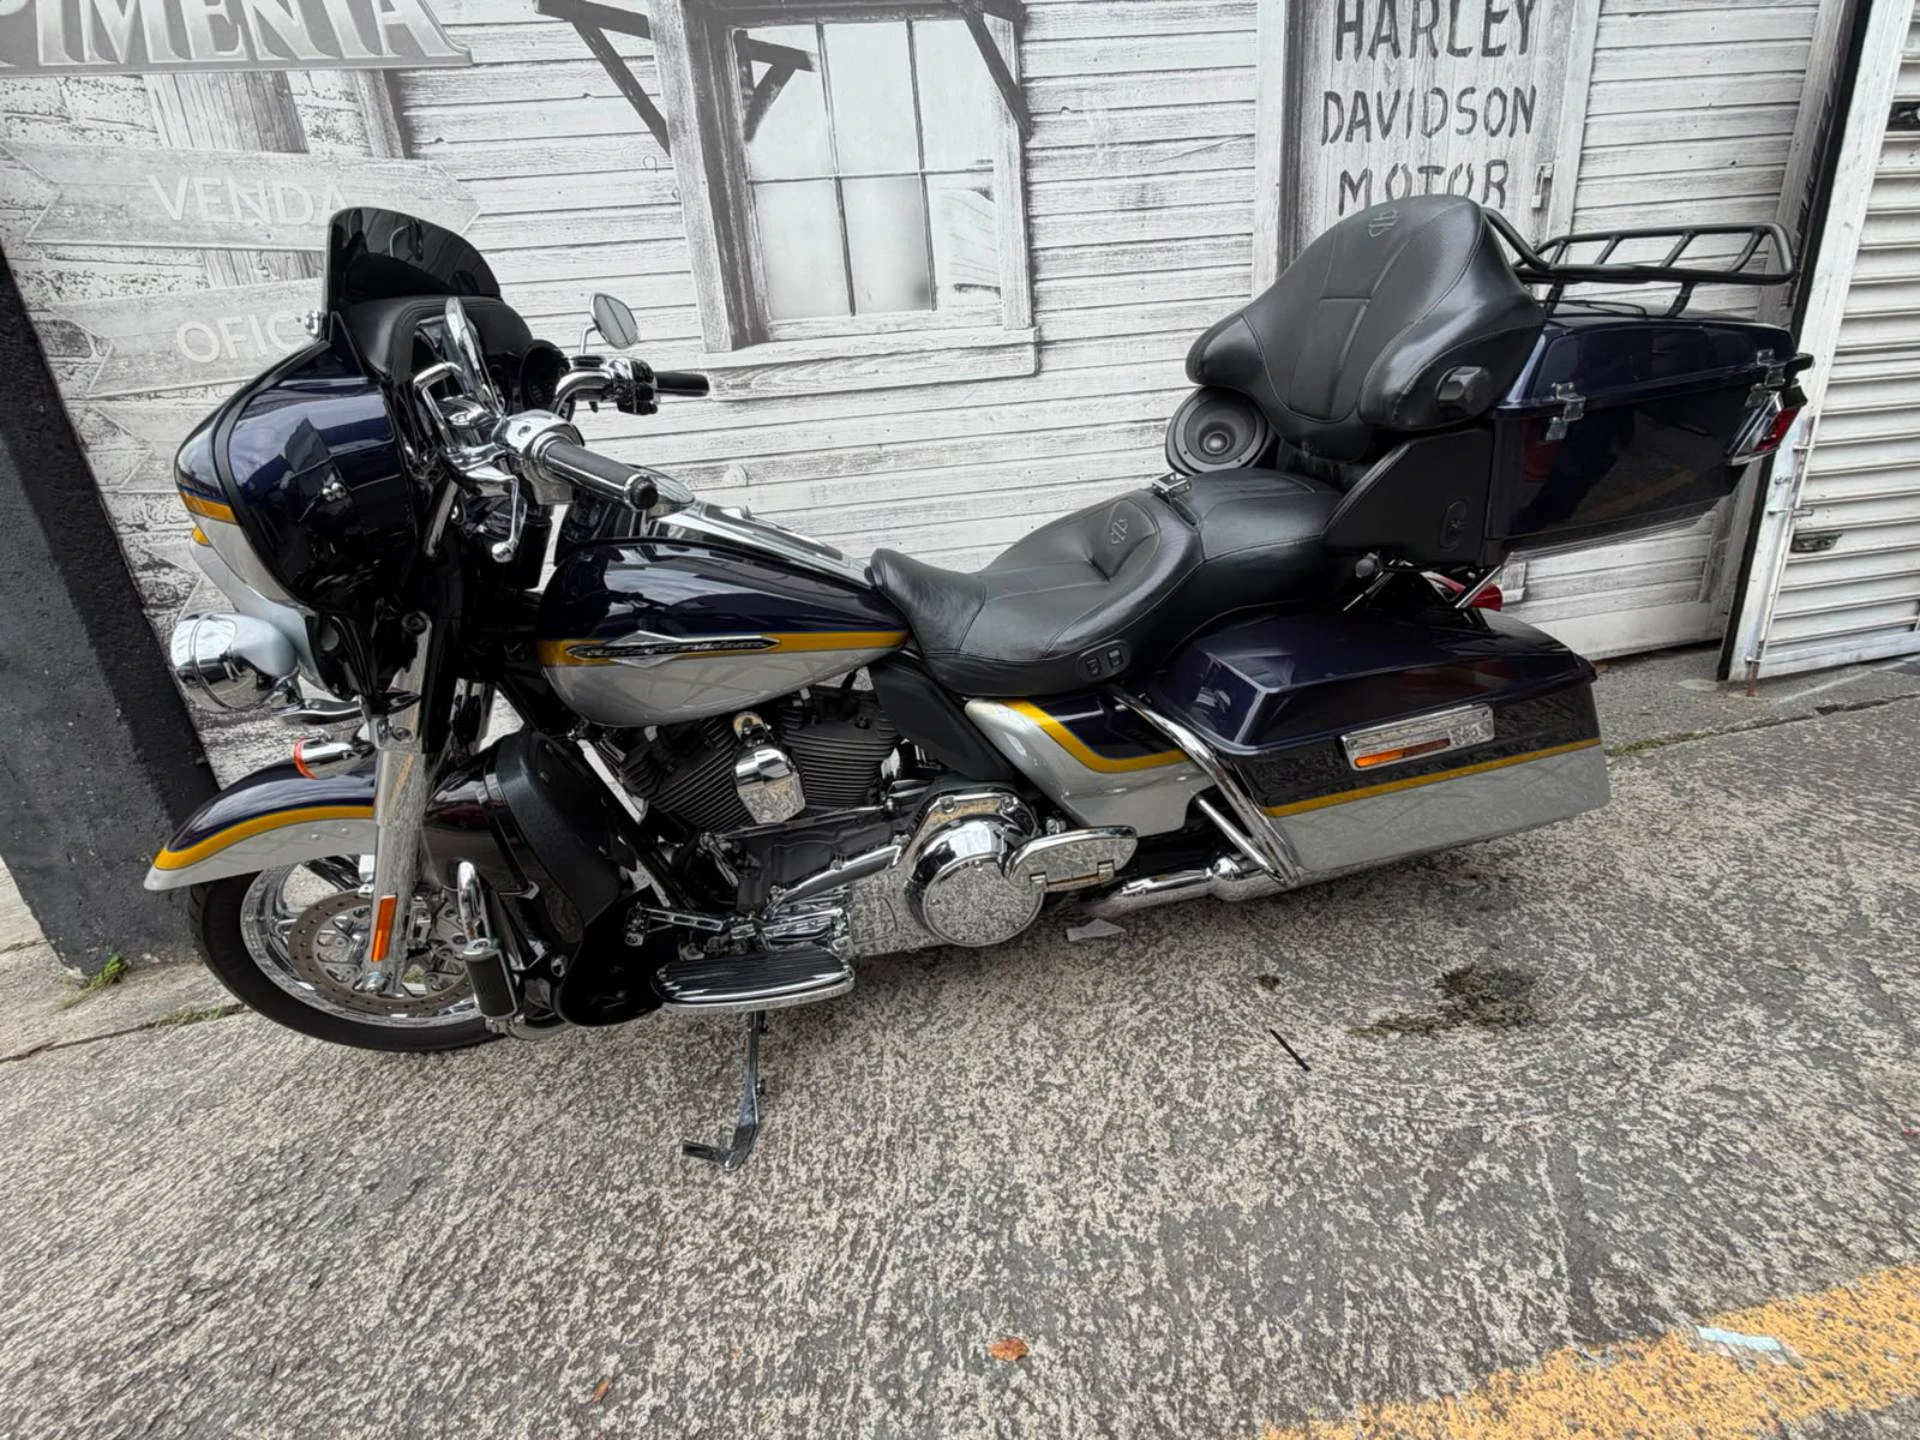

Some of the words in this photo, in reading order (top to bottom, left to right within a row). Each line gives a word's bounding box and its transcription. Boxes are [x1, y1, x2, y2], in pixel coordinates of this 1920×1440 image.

[1335, 0, 1535, 62] HARLEY
[1321, 85, 1536, 146] DAVIDSON
[147, 174, 349, 226] VENDA
[1338, 159, 1509, 216] MOTOR
[176, 310, 304, 363] OFIC
